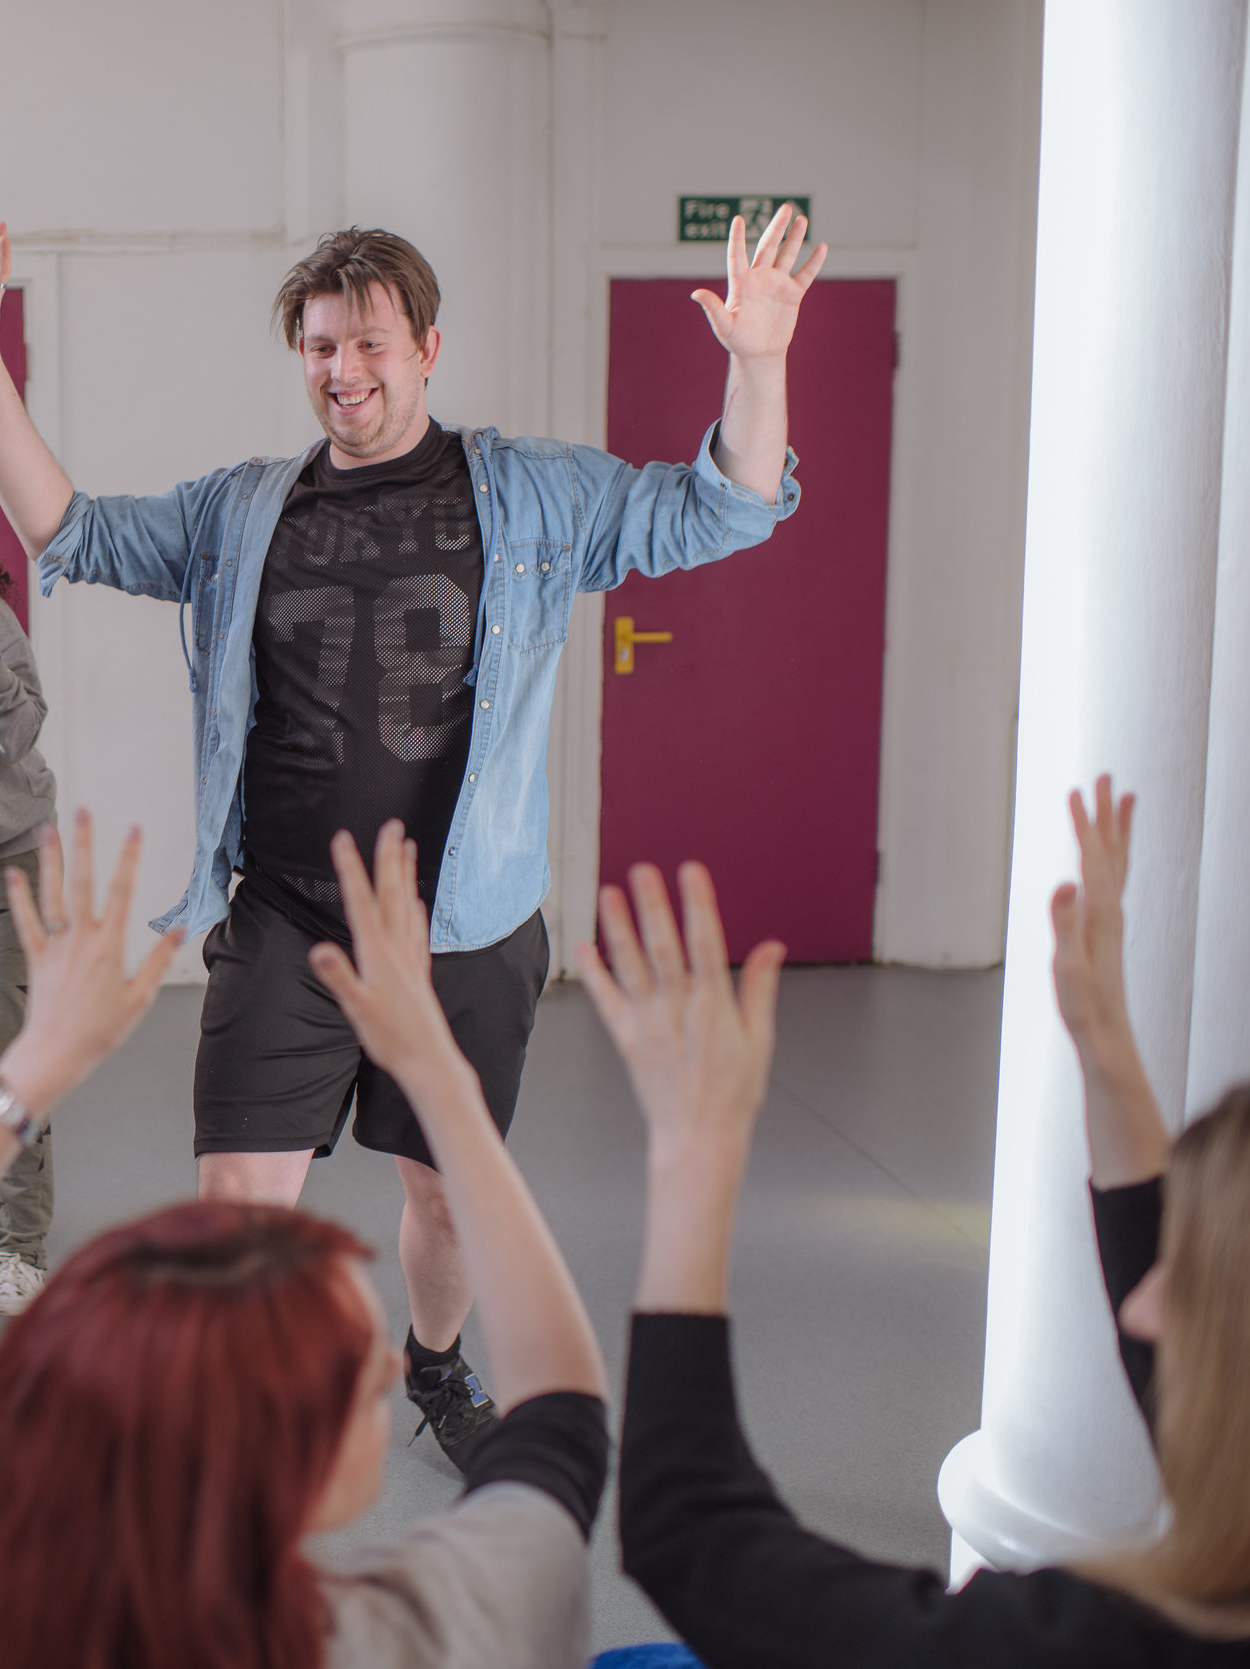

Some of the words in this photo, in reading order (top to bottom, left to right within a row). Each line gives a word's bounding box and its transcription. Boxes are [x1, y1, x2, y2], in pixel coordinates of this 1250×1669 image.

[685, 200, 730, 219] Fire
[684, 220, 728, 239] exit
[268, 573, 471, 765] 78
